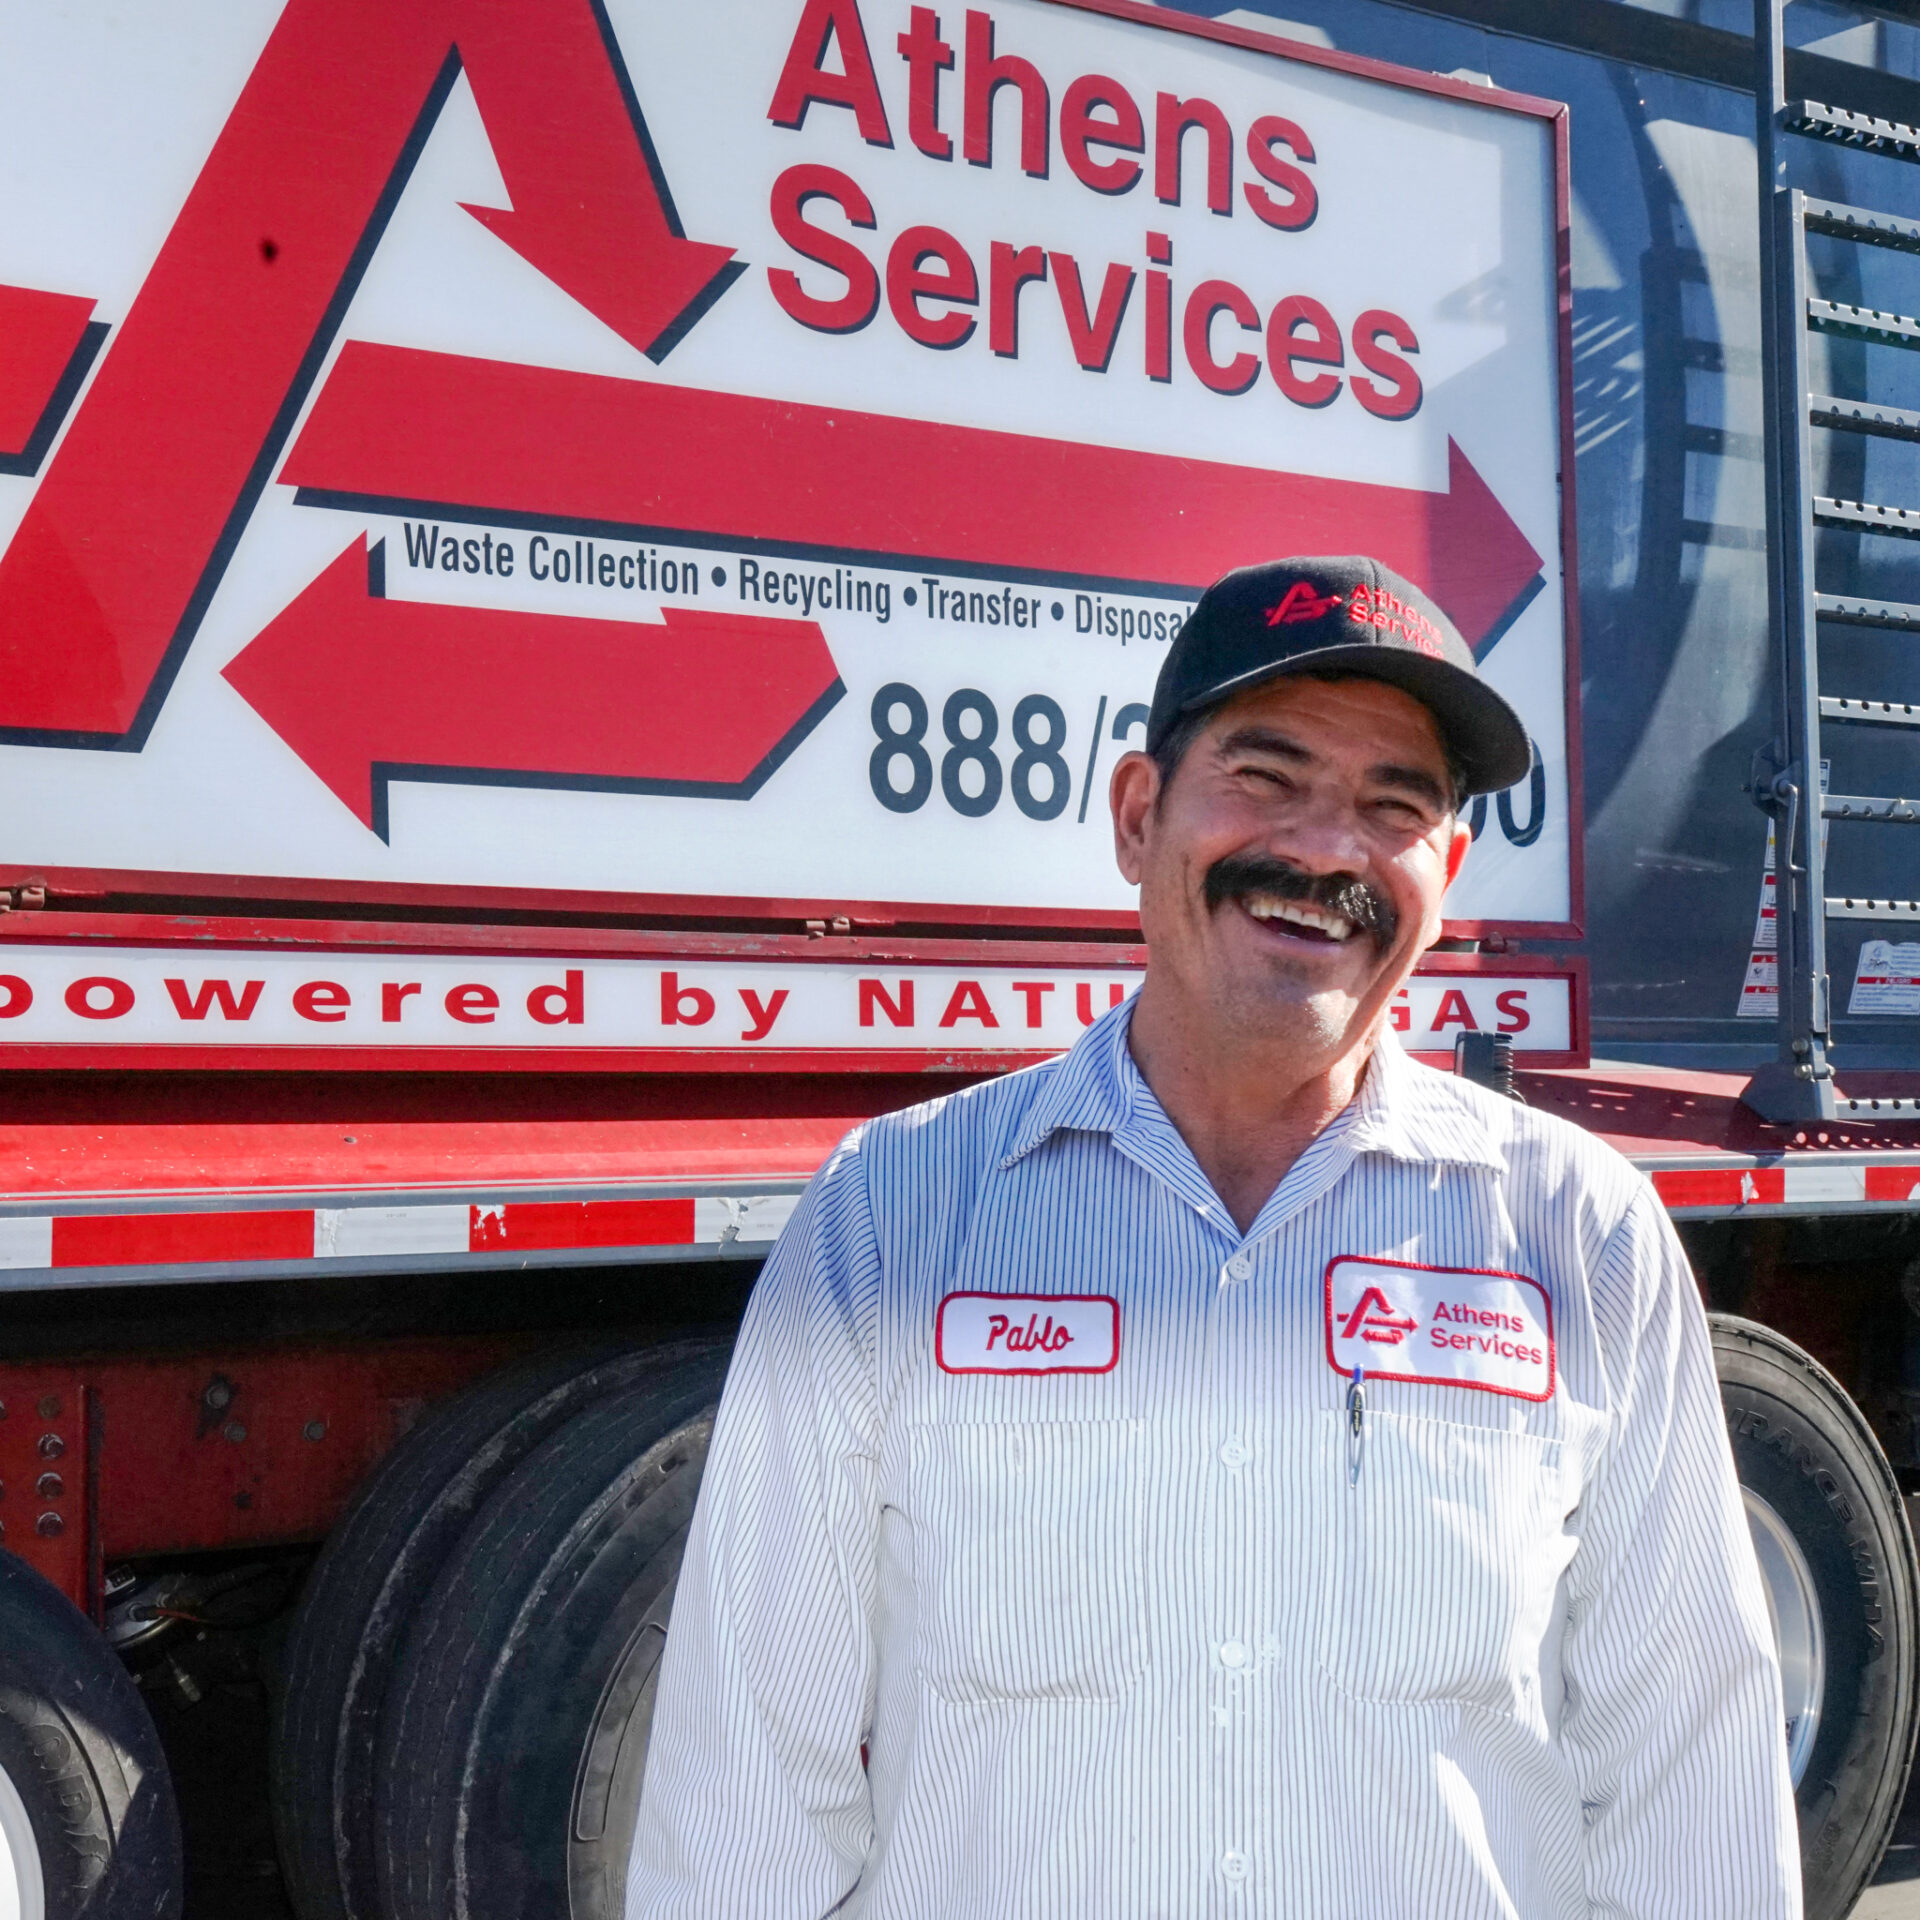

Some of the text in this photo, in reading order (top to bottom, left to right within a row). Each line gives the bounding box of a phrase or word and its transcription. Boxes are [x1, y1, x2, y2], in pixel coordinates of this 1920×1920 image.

[767, 0, 1319, 233] Athens
[767, 163, 1424, 422] Services
[403, 522, 514, 578] Waste
[528, 535, 700, 597] Collection
[739, 557, 892, 624] Recycling
[921, 577, 1041, 630] Transfer
[1350, 583, 1443, 645] Athens
[660, 971, 790, 1043] by
[986, 1313, 1074, 1353] Pablo
[1429, 1327, 1544, 1365] Services
[1433, 1301, 1525, 1334] Athens
